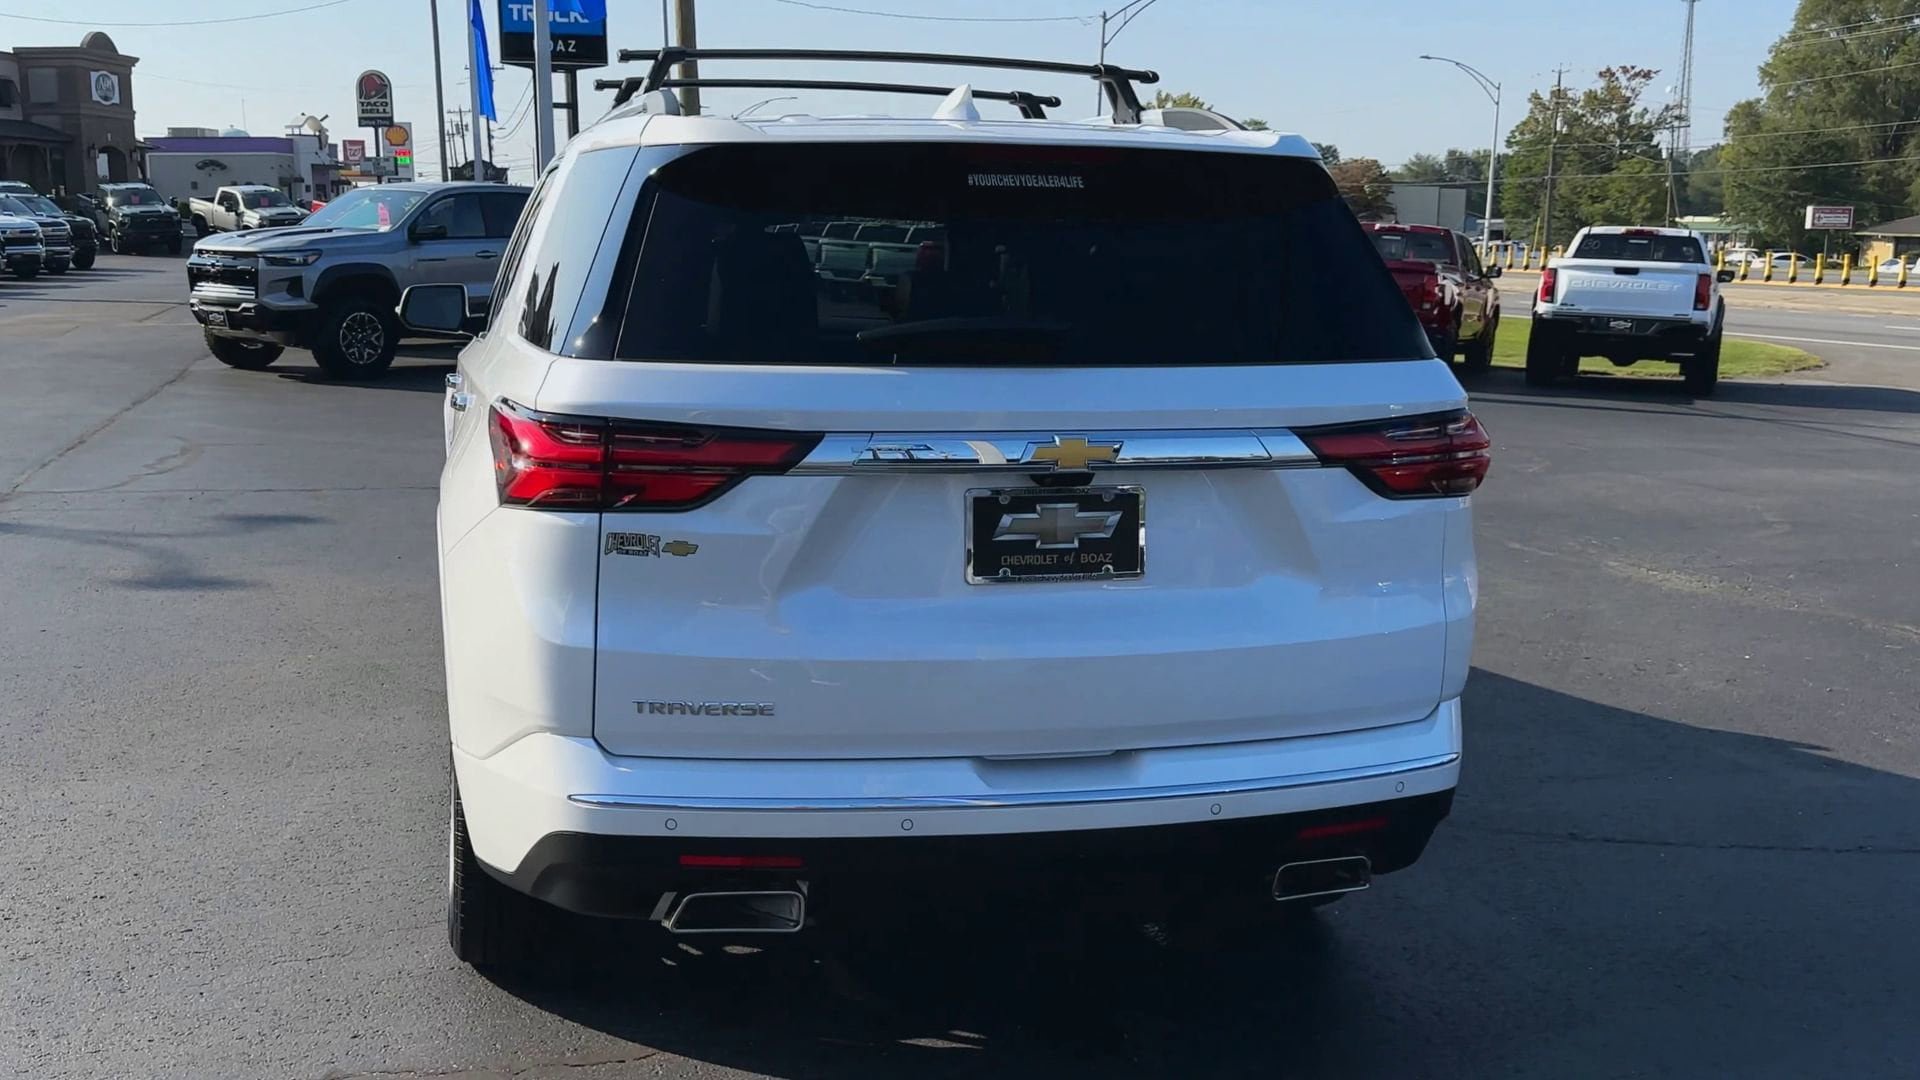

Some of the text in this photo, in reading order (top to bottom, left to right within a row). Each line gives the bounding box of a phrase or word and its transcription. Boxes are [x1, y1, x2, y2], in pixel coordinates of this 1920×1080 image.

[968, 173, 1085, 188] #YOURCHEVYDEALER4LIFE
[1570, 278, 1682, 292] CHEVROLET
[605, 532, 661, 558] CHEVROLET
[1001, 552, 1113, 566] CHEVROLET of BOAZ
[631, 699, 775, 716] TRAVERSE
